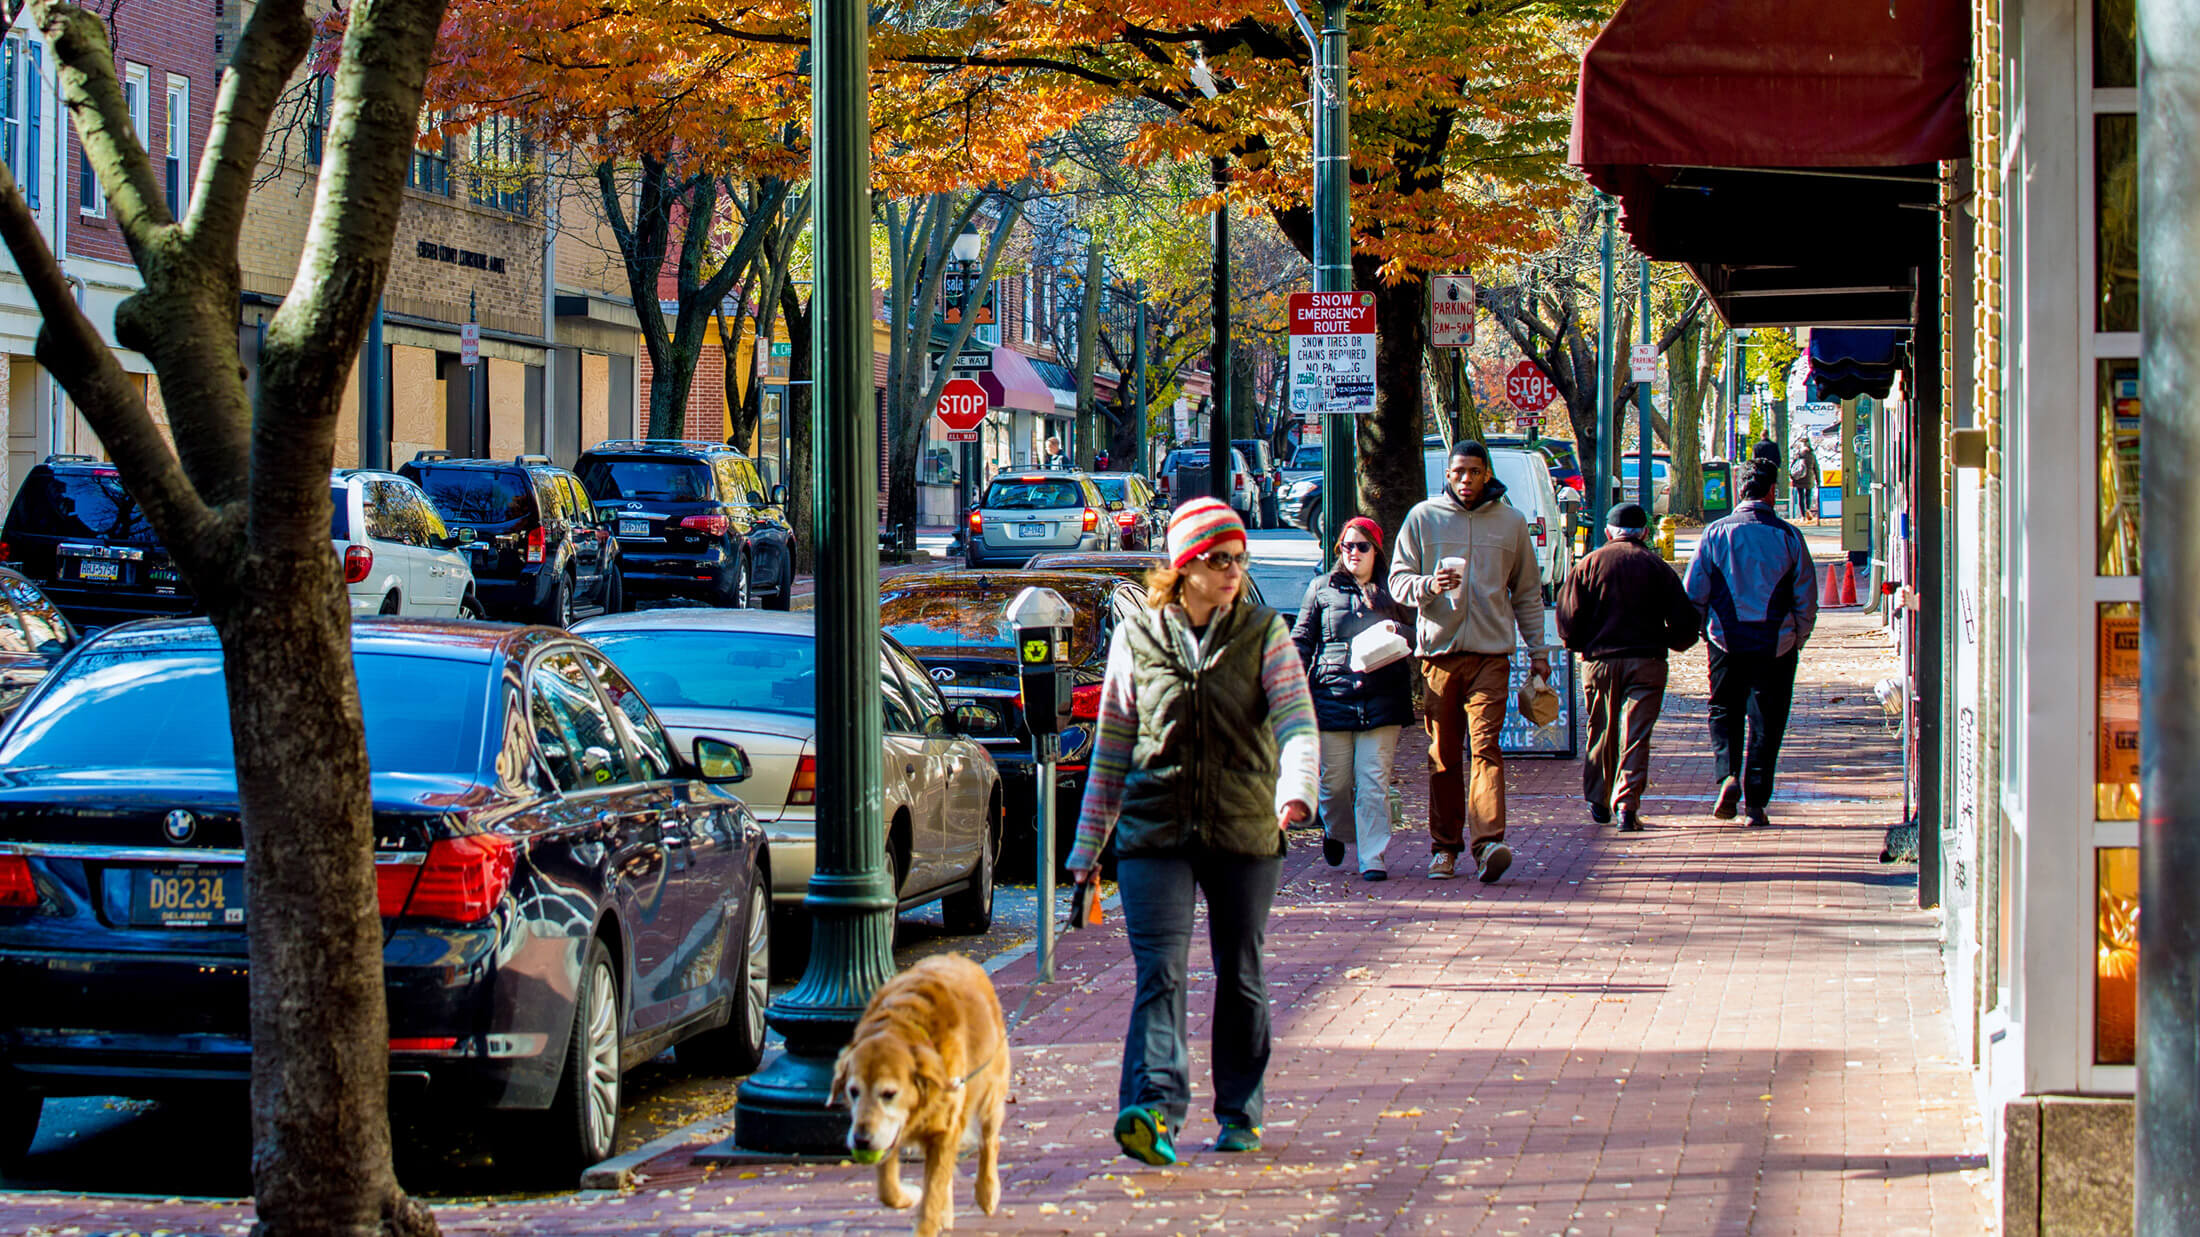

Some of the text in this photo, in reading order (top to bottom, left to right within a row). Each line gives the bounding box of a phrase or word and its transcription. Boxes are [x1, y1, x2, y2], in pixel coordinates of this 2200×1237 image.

[1312, 295, 1352, 306] SNOW
[1297, 307, 1366, 320] EMERGENCY
[1434, 302, 1472, 315] PARKING
[1314, 321, 1351, 333] ROUTE
[1302, 336, 1362, 348] SNOW TIRES OR
[969, 357, 985, 365] WAY
[1297, 349, 1325, 361] CHAINS
[1632, 356, 1655, 364] PARKING
[1306, 363, 1319, 373] NO
[1325, 374, 1371, 386] EMERGENCY
[939, 395, 984, 414] STOP
[150, 878, 225, 909] D8234
[162, 912, 212, 920] DELAWARE
